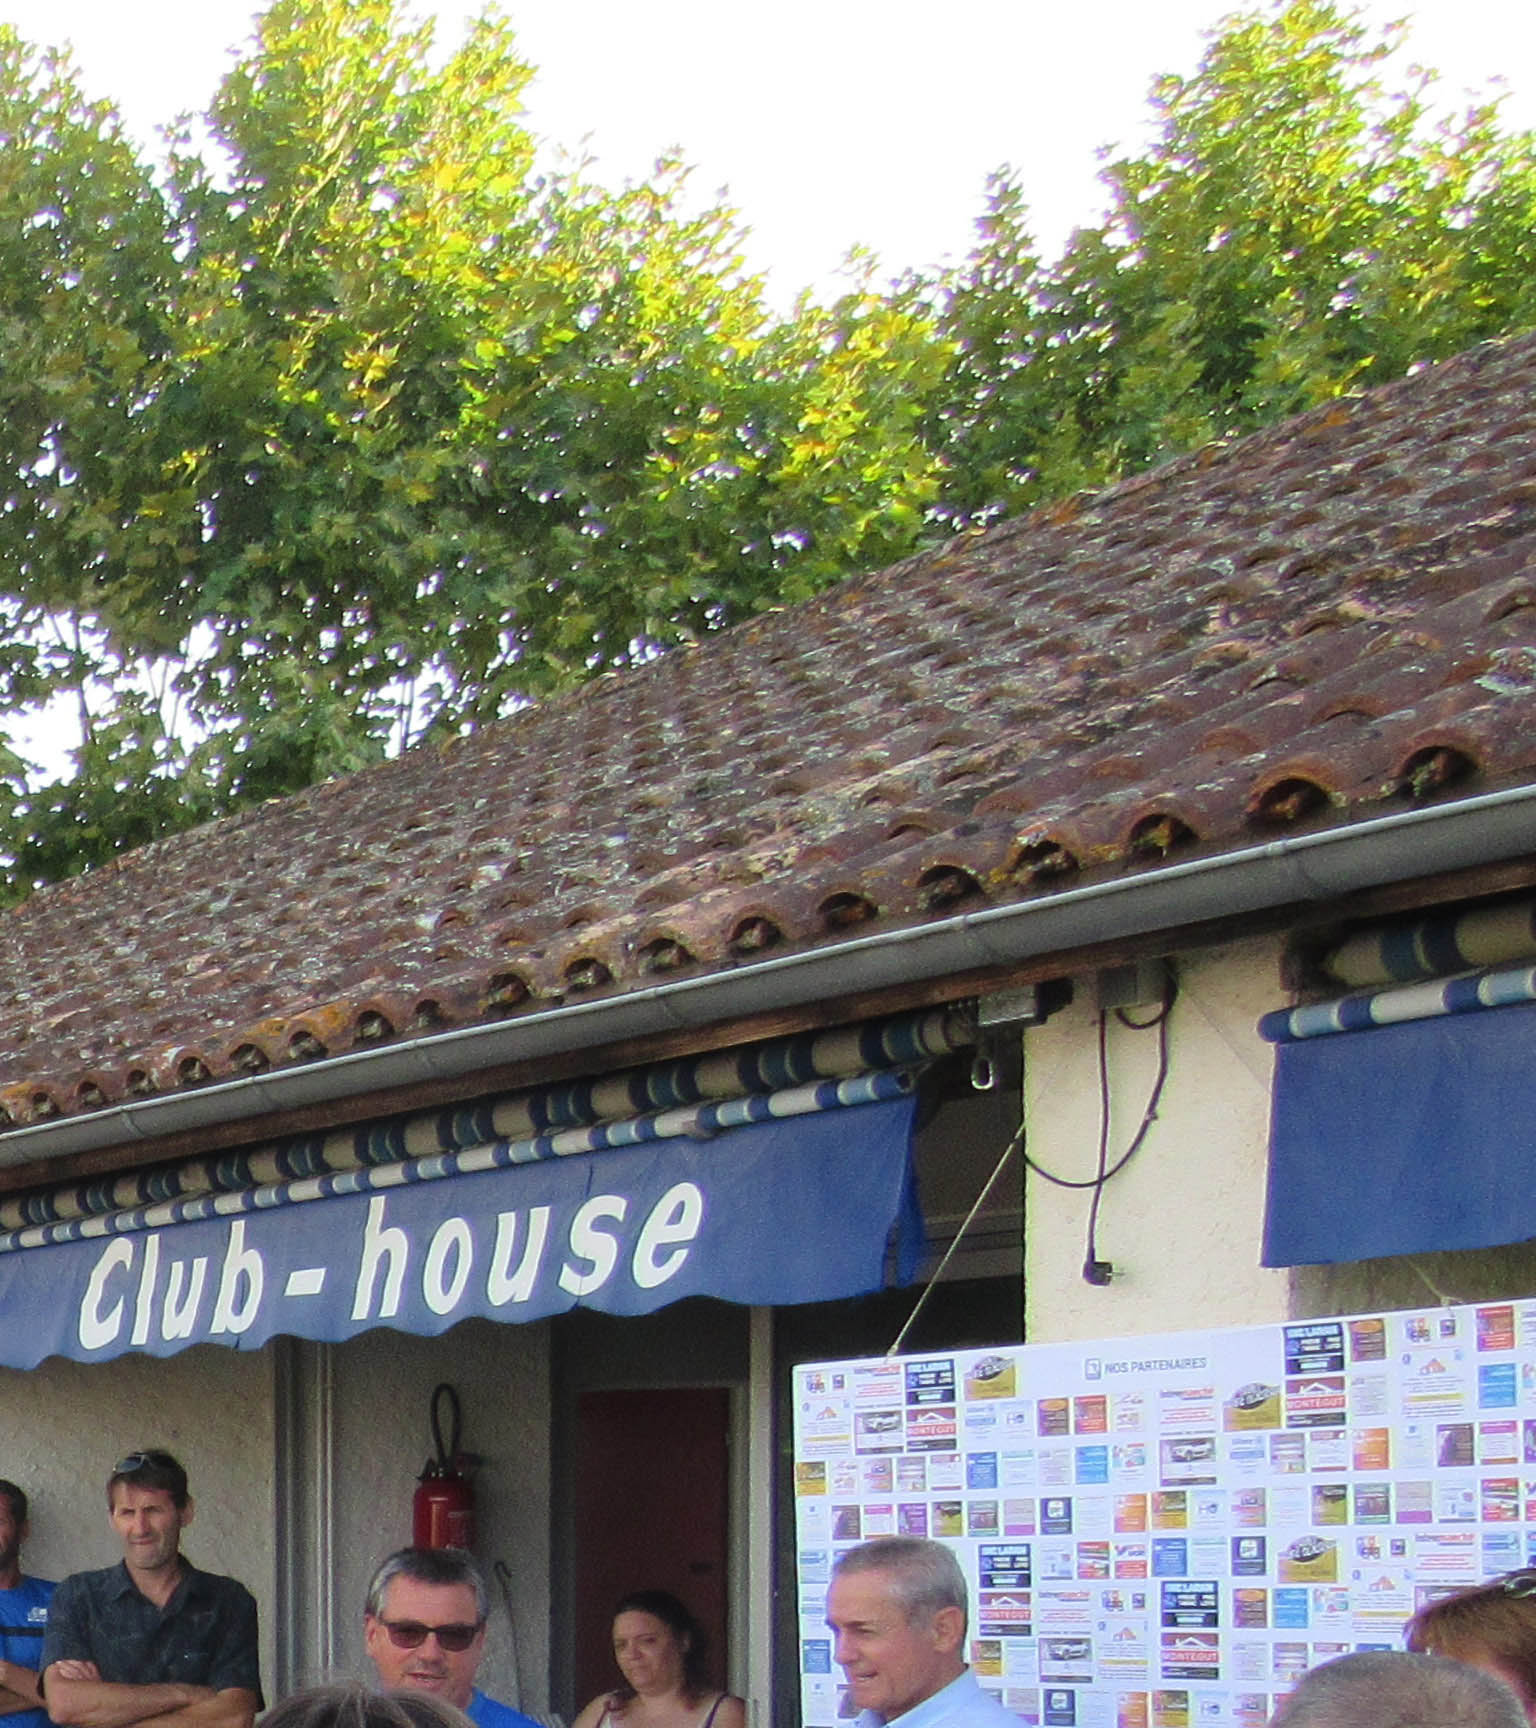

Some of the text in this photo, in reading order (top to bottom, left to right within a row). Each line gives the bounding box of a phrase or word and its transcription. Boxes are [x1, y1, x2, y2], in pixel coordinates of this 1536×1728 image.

[78, 1219, 265, 1350] Club
[350, 1182, 704, 1321] house
[1104, 1357, 1208, 1374] NOS PARTENAIRES
